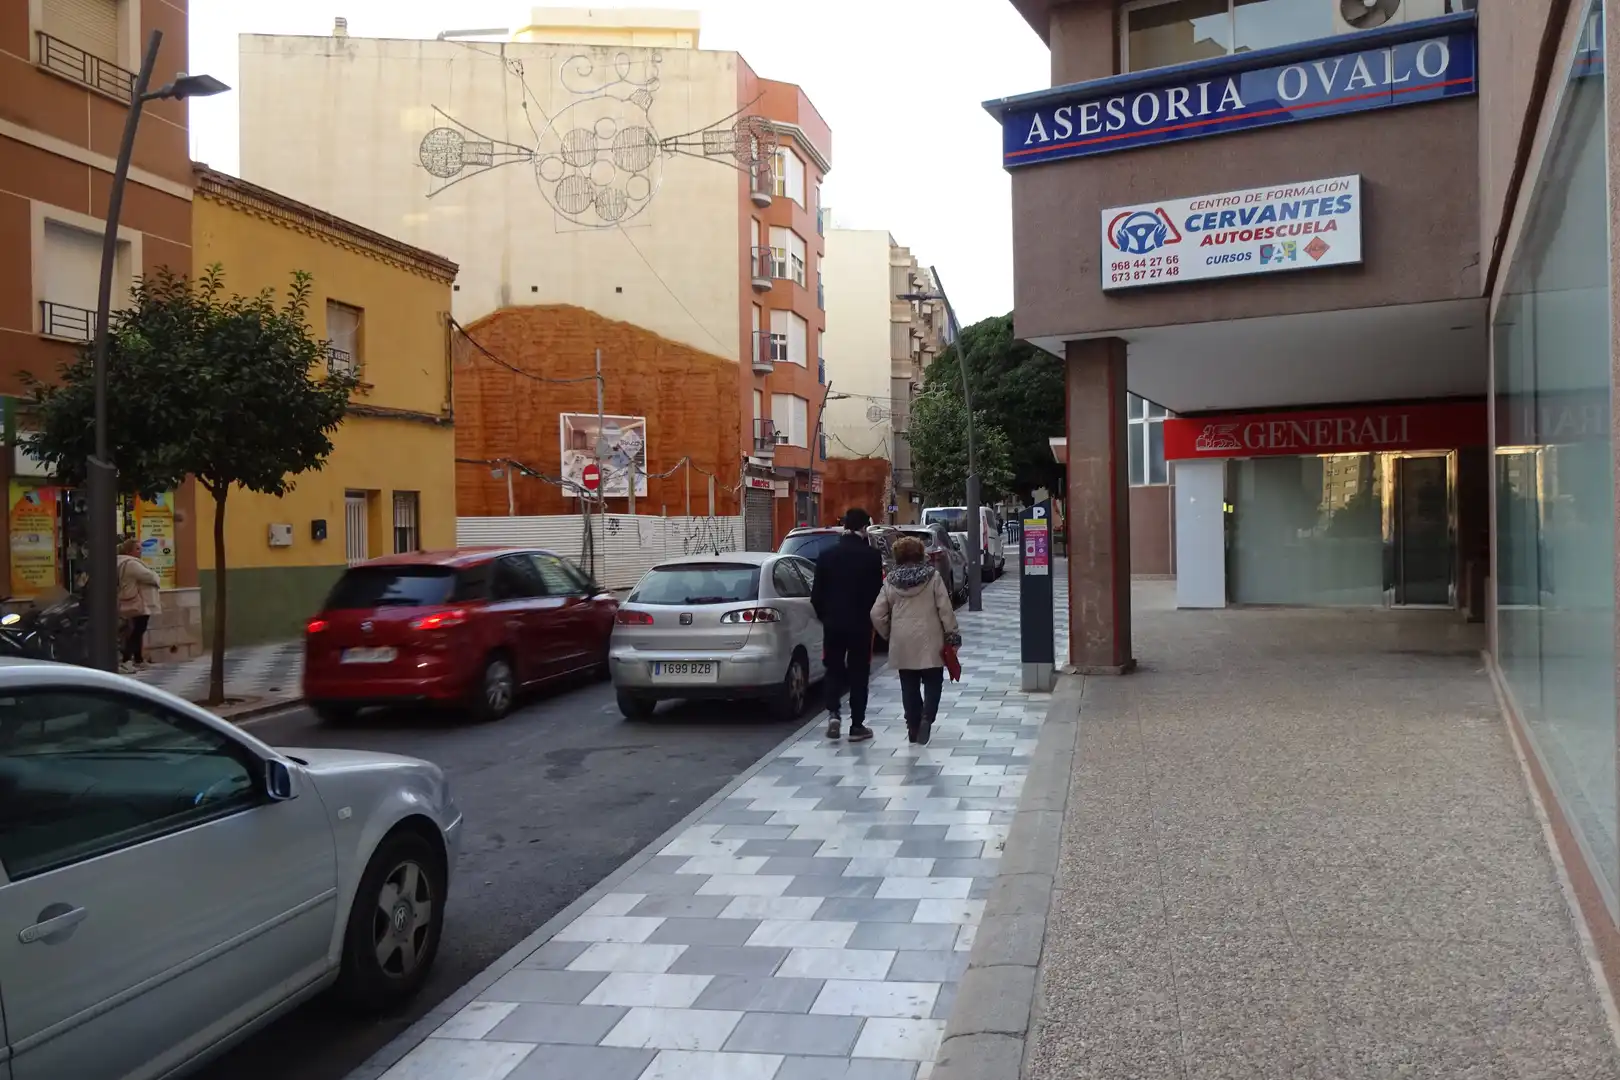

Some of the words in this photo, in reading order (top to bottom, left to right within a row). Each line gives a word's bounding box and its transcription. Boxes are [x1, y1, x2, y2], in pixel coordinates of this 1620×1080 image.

[1024, 77, 1246, 145] ASESORIA
[1277, 40, 1451, 102] OVALO
[1189, 196, 1241, 211] CENTRO
[1245, 192, 1263, 203] DE
[1266, 180, 1350, 201] FORMACIÓN
[1184, 194, 1353, 232] CERVANTES
[1200, 219, 1338, 247] AUTOESCUELA
[1111, 260, 1131, 271] 968
[1133, 259, 1147, 269] 44
[1149, 257, 1163, 267] 27
[1165, 255, 1179, 265] 66
[1205, 252, 1253, 265] CURSOS
[1260, 241, 1296, 264] CAP
[1111, 272, 1131, 283] 673
[1133, 271, 1147, 280] 87
[1149, 268, 1163, 278] 27
[1165, 267, 1180, 276] 48
[1243, 414, 1411, 449] GENERALI
[1032, 506, 1046, 519] P
[663, 663, 688, 674] 1699
[691, 663, 711, 674] BZB
